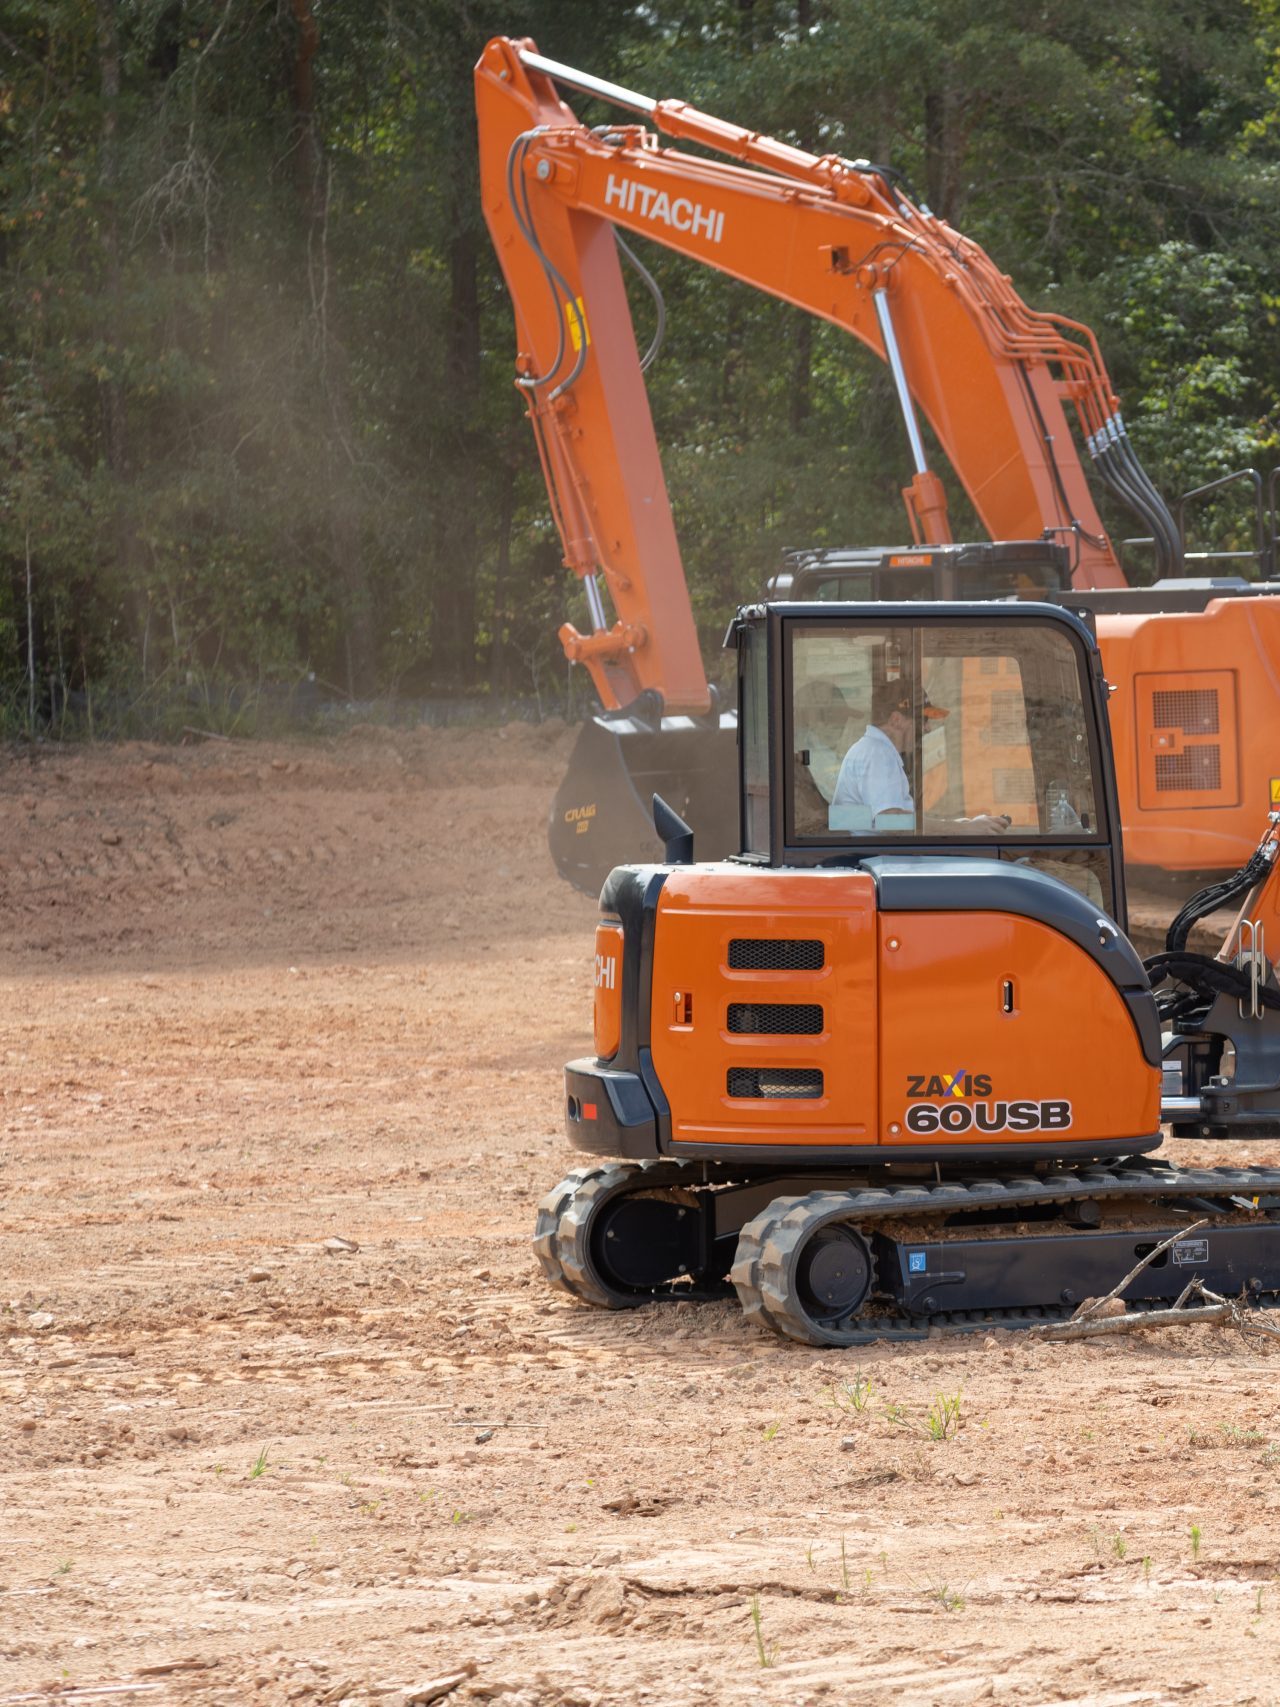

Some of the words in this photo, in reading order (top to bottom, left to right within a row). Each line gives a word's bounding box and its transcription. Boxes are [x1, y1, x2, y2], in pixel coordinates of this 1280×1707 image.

[604, 173, 725, 243] HITACHI
[906, 1069, 993, 1098] ZAXIS
[905, 1100, 1071, 1133] 60USB
